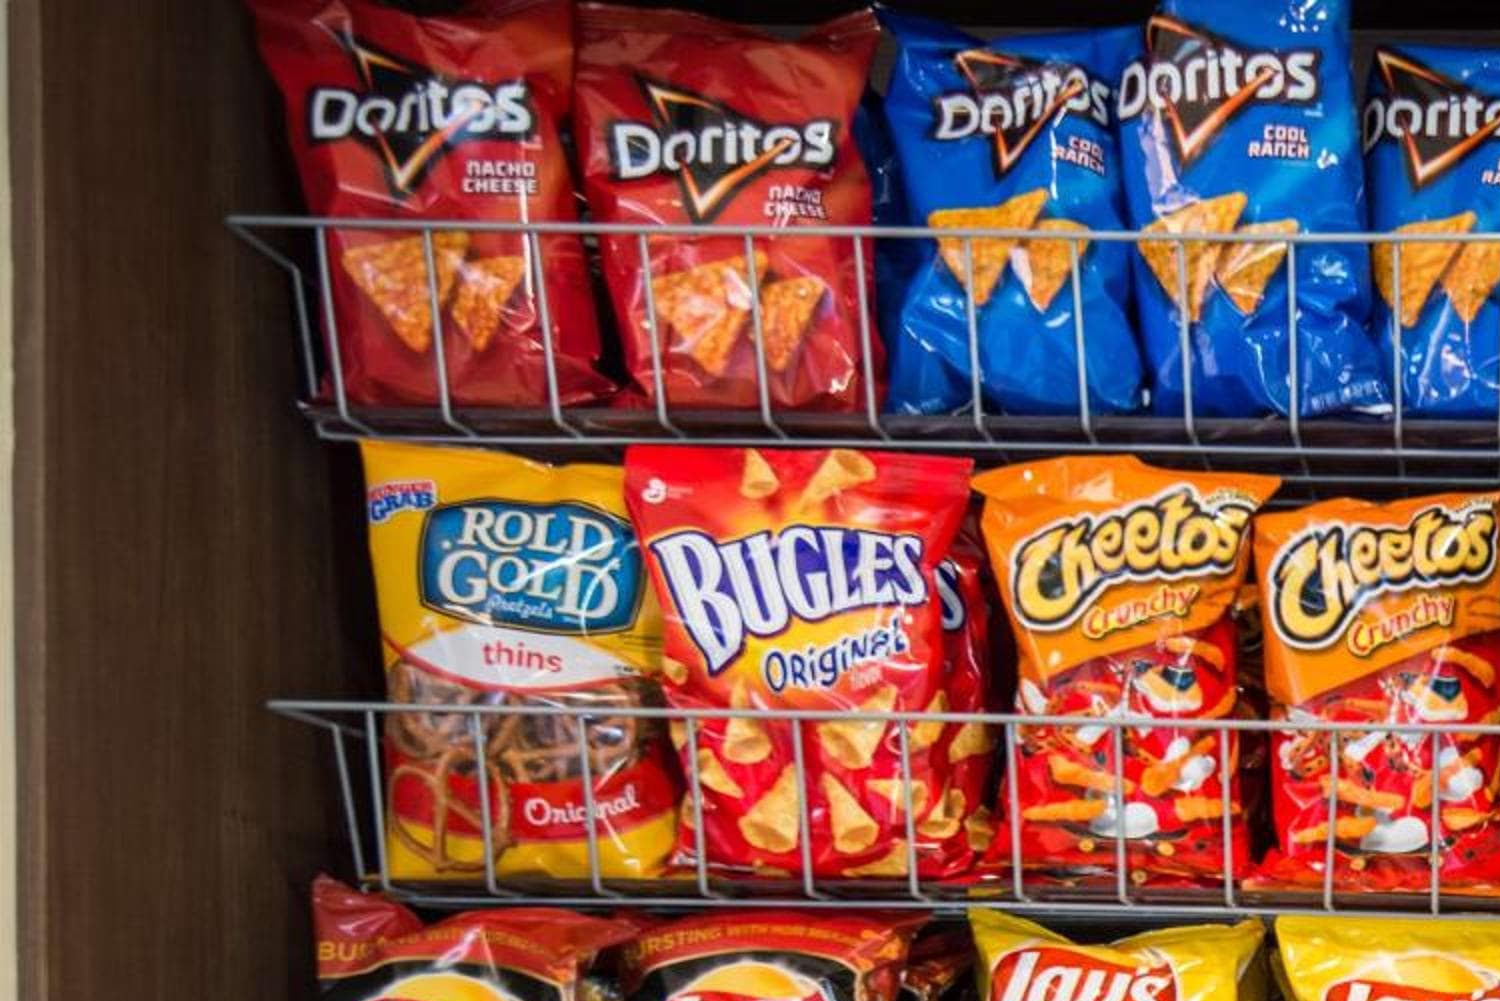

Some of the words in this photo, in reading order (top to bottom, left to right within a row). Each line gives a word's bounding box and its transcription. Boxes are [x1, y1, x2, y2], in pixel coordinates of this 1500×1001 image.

[310, 81, 534, 138] Doritos
[935, 61, 1112, 141] Doritos
[1117, 50, 1321, 119] Doritos
[613, 121, 835, 180] Doritos
[1068, 135, 1106, 155] COOL
[1248, 139, 1310, 159] RANCH
[1263, 123, 1309, 141] COOL
[462, 176, 538, 194] CHEESE
[465, 160, 536, 177] NACHO
[1057, 145, 1106, 176] RANCH
[457, 507, 617, 561] ROLD
[1016, 490, 1252, 624] Cheetos
[438, 551, 619, 618] GOLD
[652, 526, 929, 675] BUGLES
[1276, 509, 1498, 642] Cheetos
[1083, 585, 1197, 638] Crunchy
[1347, 594, 1455, 655] Crunchy
[482, 641, 563, 672] thins
